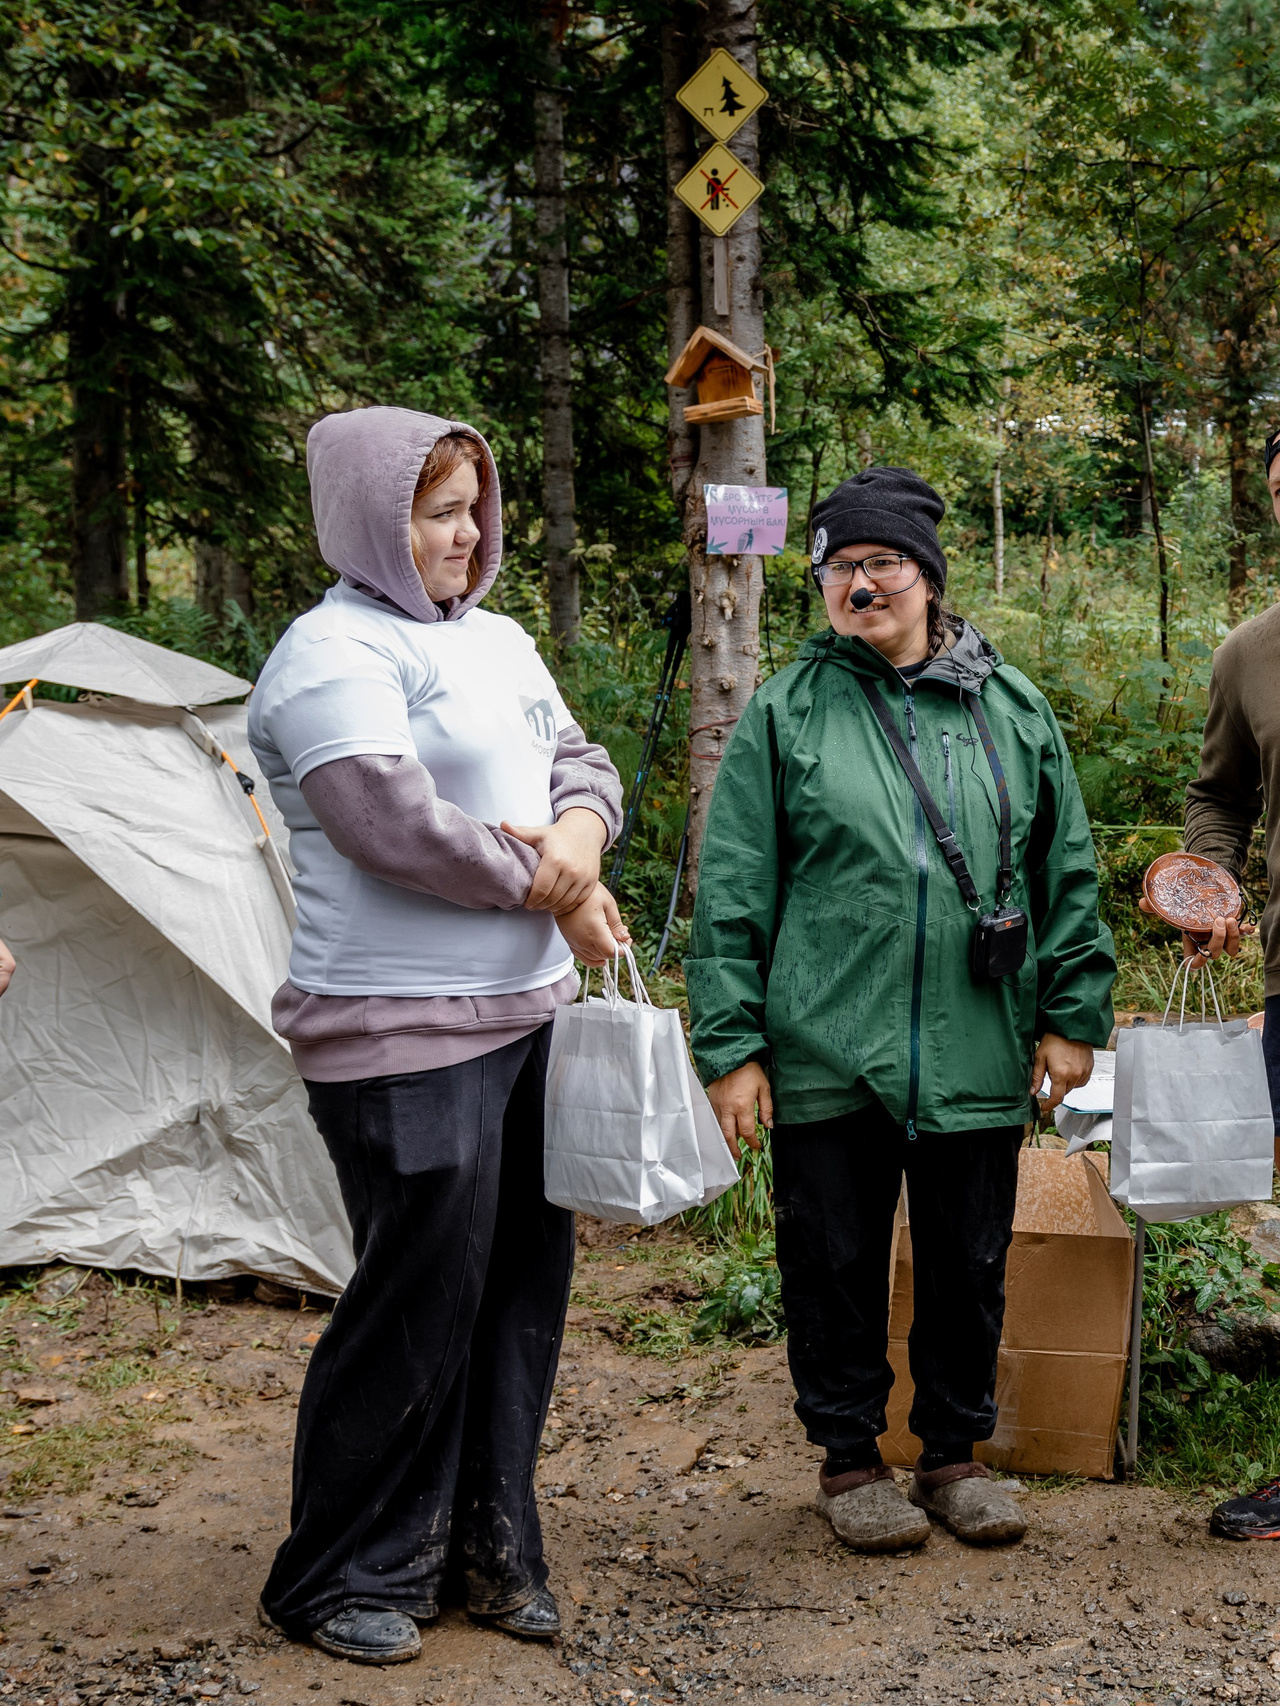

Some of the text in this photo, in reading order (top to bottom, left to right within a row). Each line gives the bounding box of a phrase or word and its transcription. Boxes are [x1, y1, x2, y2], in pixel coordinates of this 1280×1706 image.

[728, 505, 769, 515] МУСОР В
[710, 516, 765, 527] МУСОРНЫЙ
